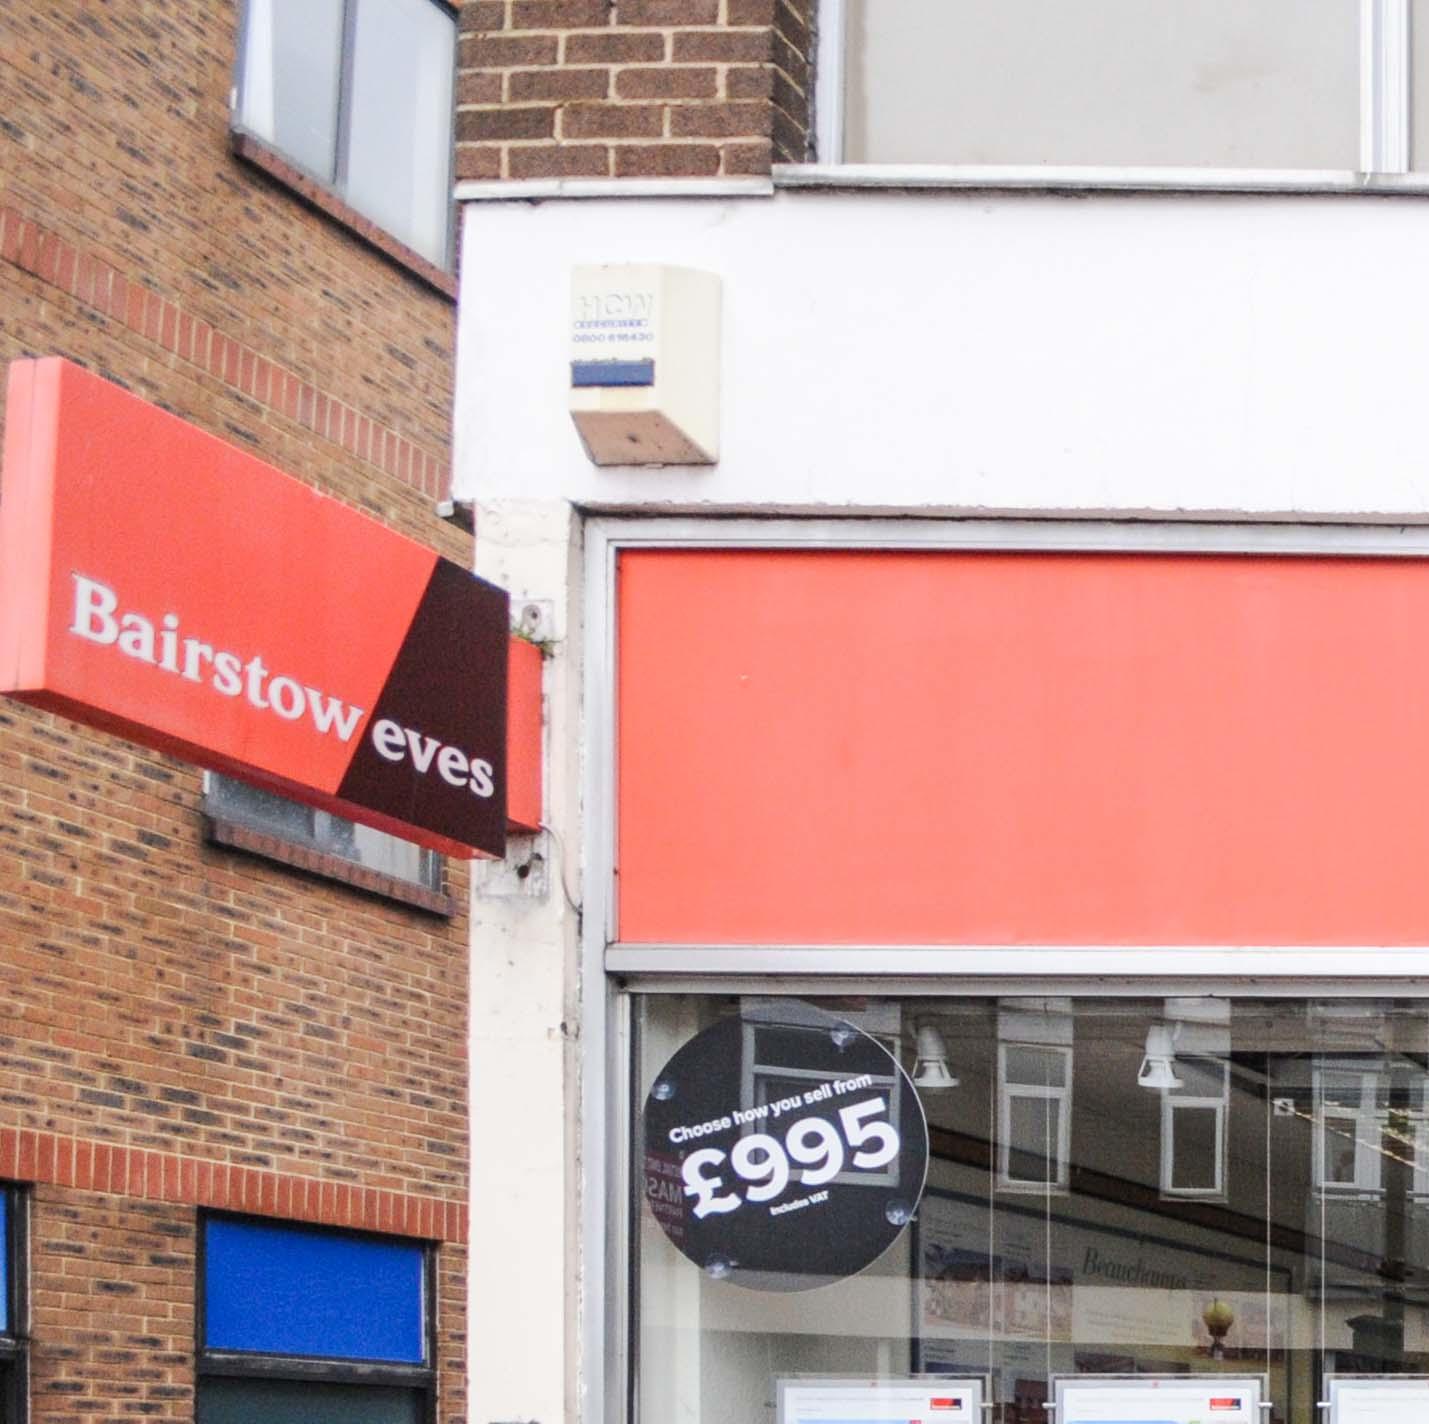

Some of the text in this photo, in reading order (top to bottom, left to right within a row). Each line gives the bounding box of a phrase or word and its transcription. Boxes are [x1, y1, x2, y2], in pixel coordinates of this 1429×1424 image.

[70, 570, 496, 799] Bairstow eves
[668, 1073, 873, 1144] Choose how you sell from
[681, 1096, 900, 1220] £995
[769, 1189, 829, 1216] Includes VAT
